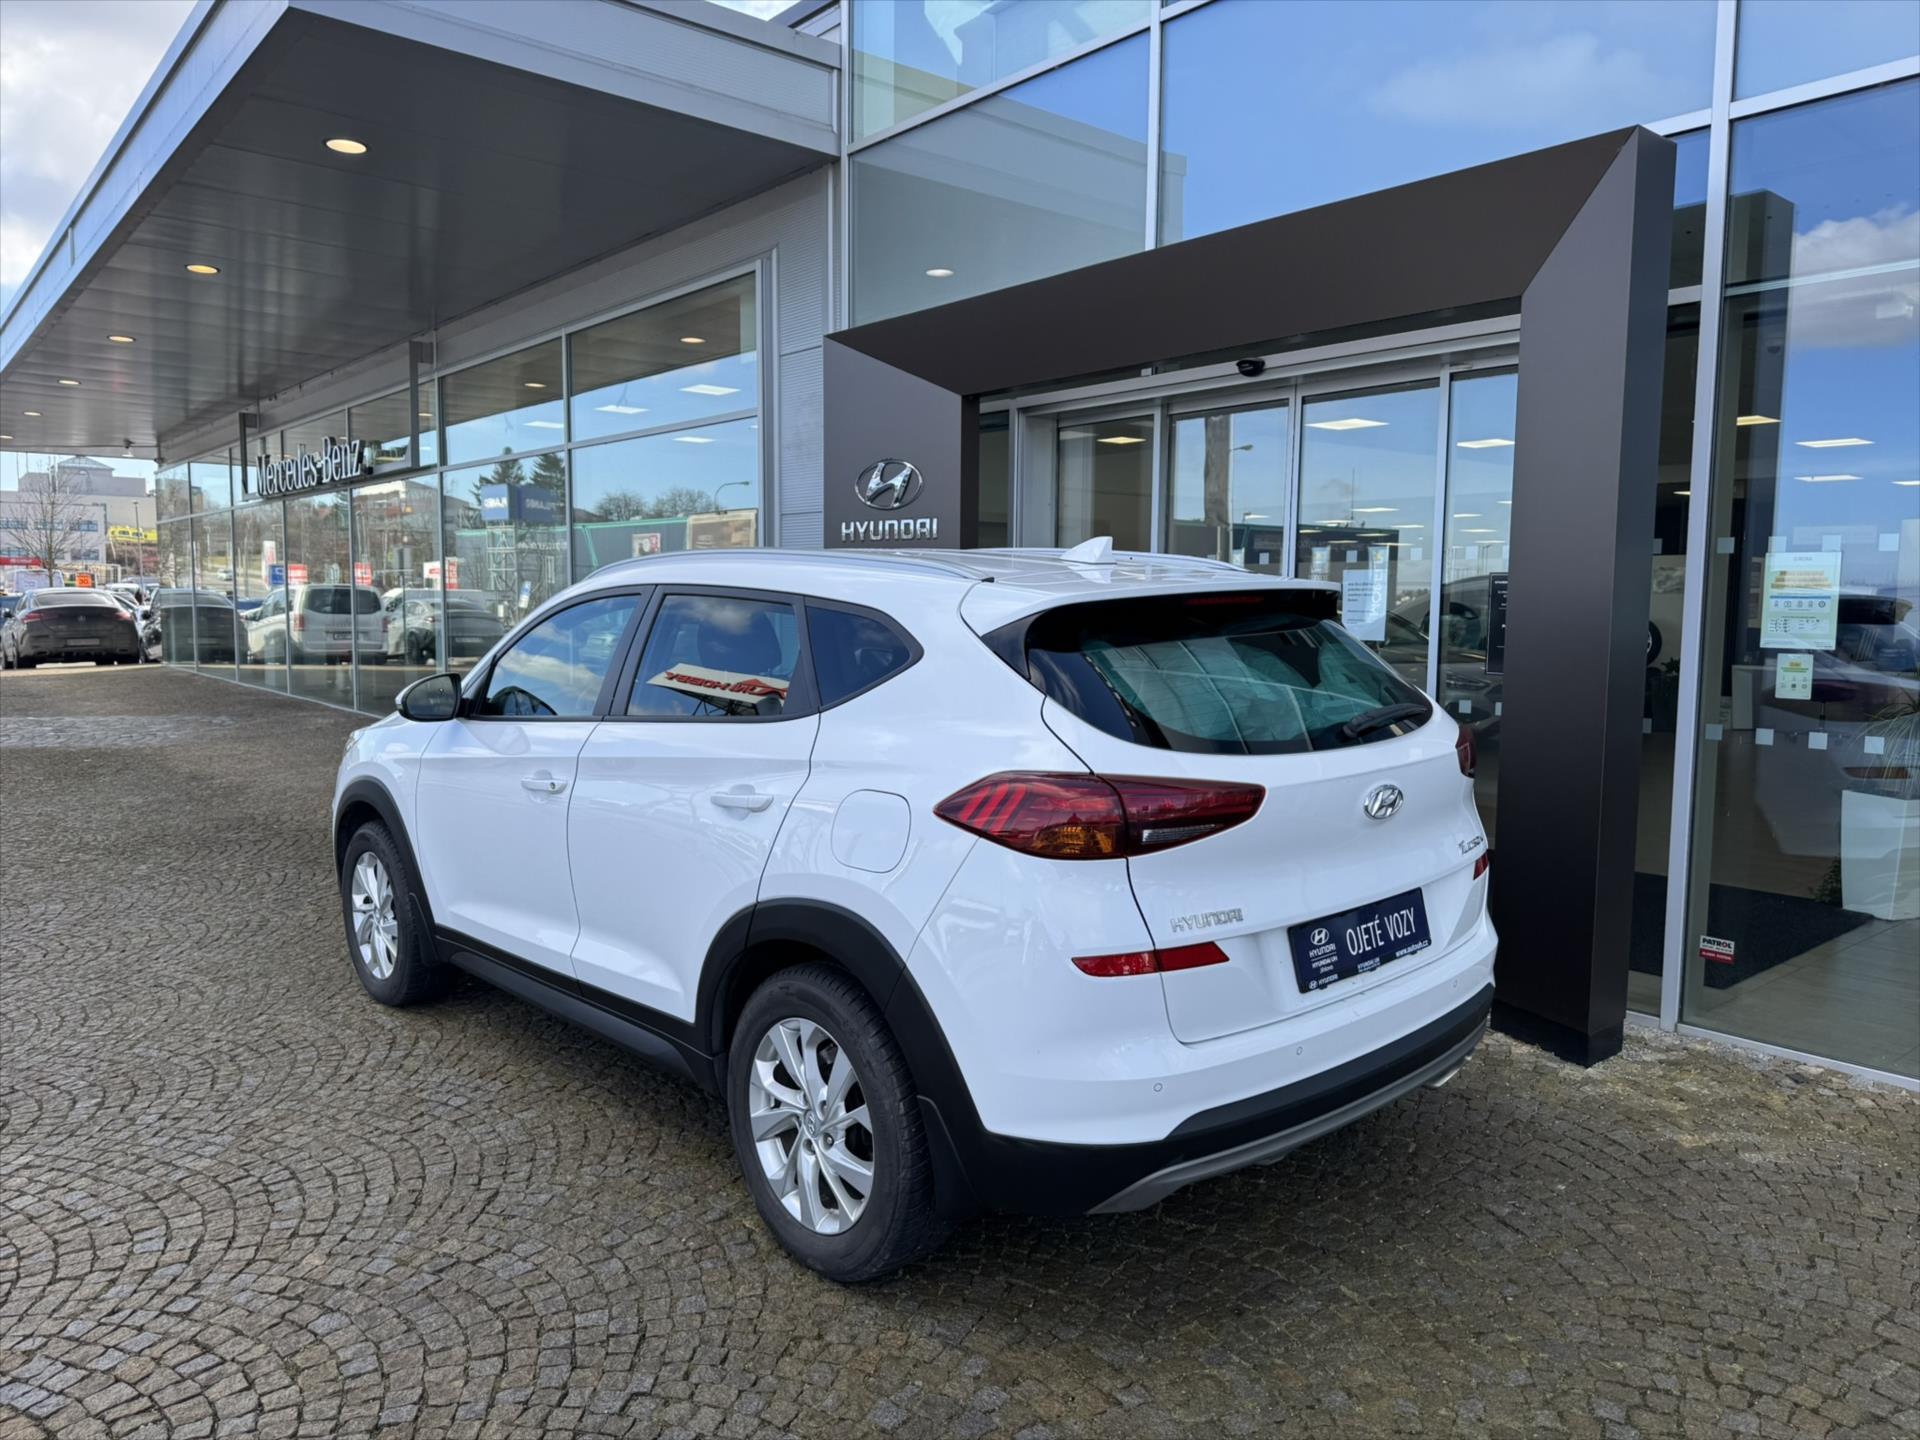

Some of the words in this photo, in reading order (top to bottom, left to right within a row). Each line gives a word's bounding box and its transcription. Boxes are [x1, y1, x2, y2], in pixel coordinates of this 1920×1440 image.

[256, 436, 360, 496] Mercedes-Benz
[841, 517, 938, 541] HYUNDAI
[1170, 908, 1243, 932] HYUNDAI
[1346, 914, 1384, 955] OJETÉ
[1384, 907, 1415, 941] VOZY
[1309, 943, 1336, 958] HYUNDAI
[1702, 938, 1733, 949] PATROL
